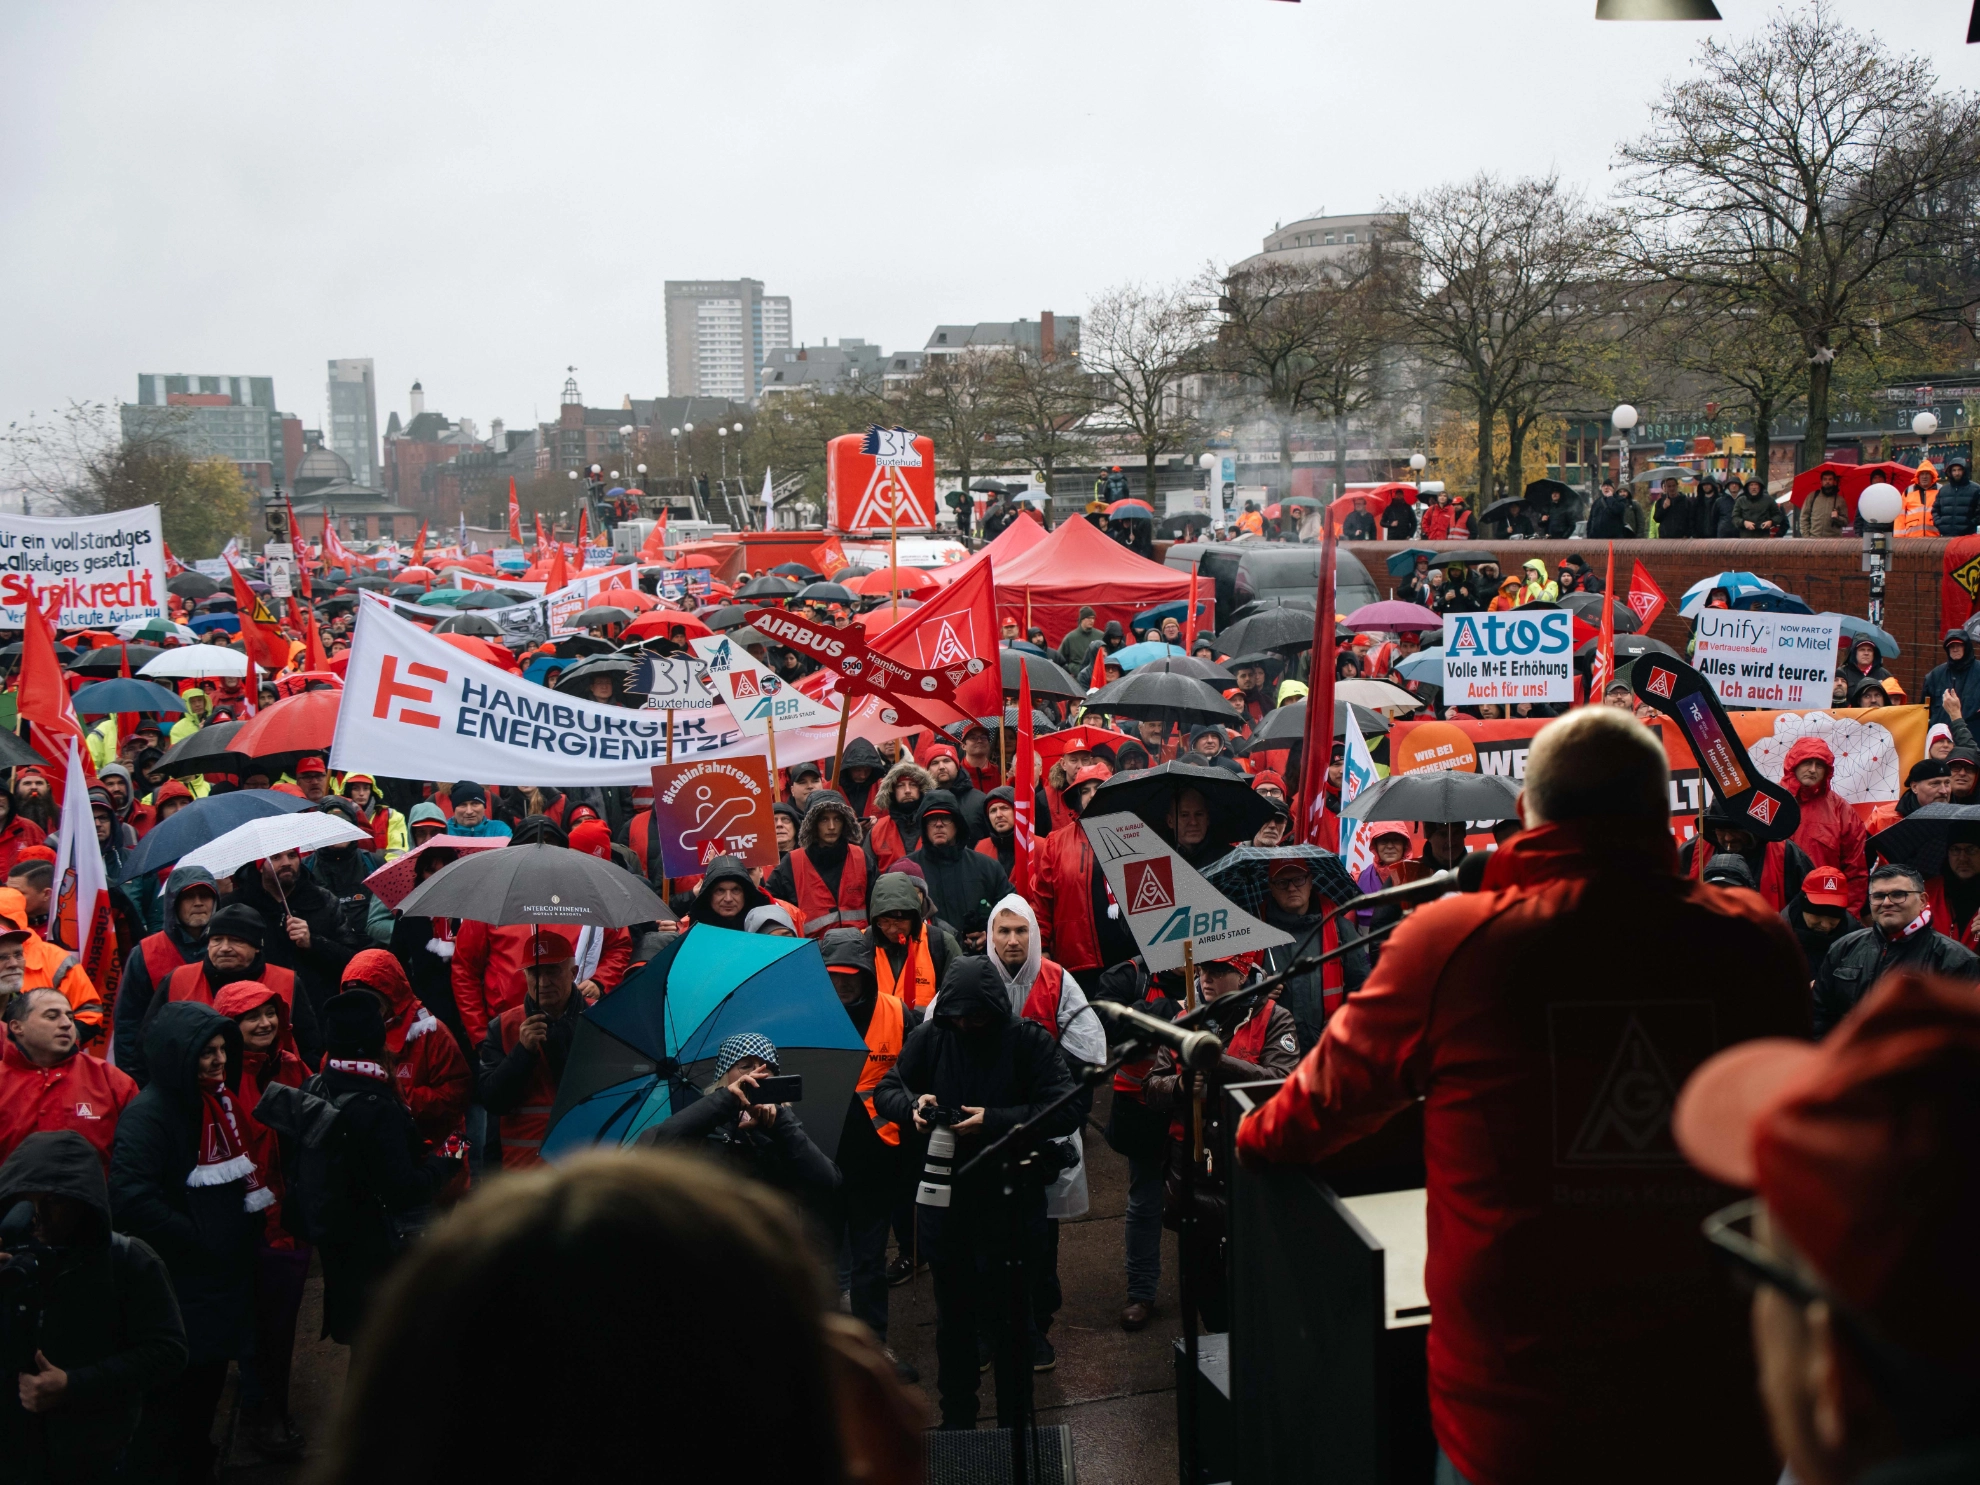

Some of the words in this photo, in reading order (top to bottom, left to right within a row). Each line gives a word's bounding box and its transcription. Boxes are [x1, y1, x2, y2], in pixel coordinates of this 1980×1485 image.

[876, 458, 921, 466] Buxtehude
[0, 531, 17, 549] ür
[21, 534, 45, 549] ein
[51, 529, 152, 551] vollständiges
[8, 552, 79, 575] allseitiges
[84, 549, 141, 574] gesetzl.
[752, 614, 845, 657] AIRBUS
[1701, 617, 1764, 645] Unify
[1780, 625, 1800, 633] NOW
[1801, 626, 1820, 634] PART
[1710, 643, 1768, 654] Vertrauensleute
[1797, 637, 1831, 651] Mitel
[709, 664, 731, 673] STADE
[866, 652, 912, 681] Hamburg
[1447, 662, 1478, 678] Volle
[1482, 660, 1507, 677] M+E
[1511, 660, 1568, 679] Erhöhung
[1700, 657, 1736, 676] Alles
[1741, 661, 1774, 678] wird
[1778, 665, 1828, 683] teurer.
[1467, 682, 1498, 697] Auch
[1502, 681, 1519, 697] für
[1522, 681, 1548, 697] uns!
[1720, 680, 1742, 697] Ich
[1747, 684, 1783, 700] auch
[1788, 685, 1803, 702] !!!
[461, 677, 707, 738] HAMBURGER
[648, 698, 712, 709] Buxtehude
[775, 698, 799, 716] BR
[779, 712, 799, 722] AIRBUS
[799, 710, 816, 719] STADE
[456, 706, 739, 760] ENERGIENETZE
[1414, 749, 1436, 762] WIR
[1436, 743, 1453, 757] BEI
[1713, 738, 1742, 787] Fahrtreppen
[1707, 748, 1730, 787] Hamburg
[661, 762, 761, 804] #ichbinFahrtreppe
[1123, 831, 1140, 840] STADE
[1124, 822, 1144, 832] AIRBUS
[1192, 908, 1229, 937] BR
[1198, 932, 1226, 945] AIRBUS
[1227, 927, 1251, 939] STADE
